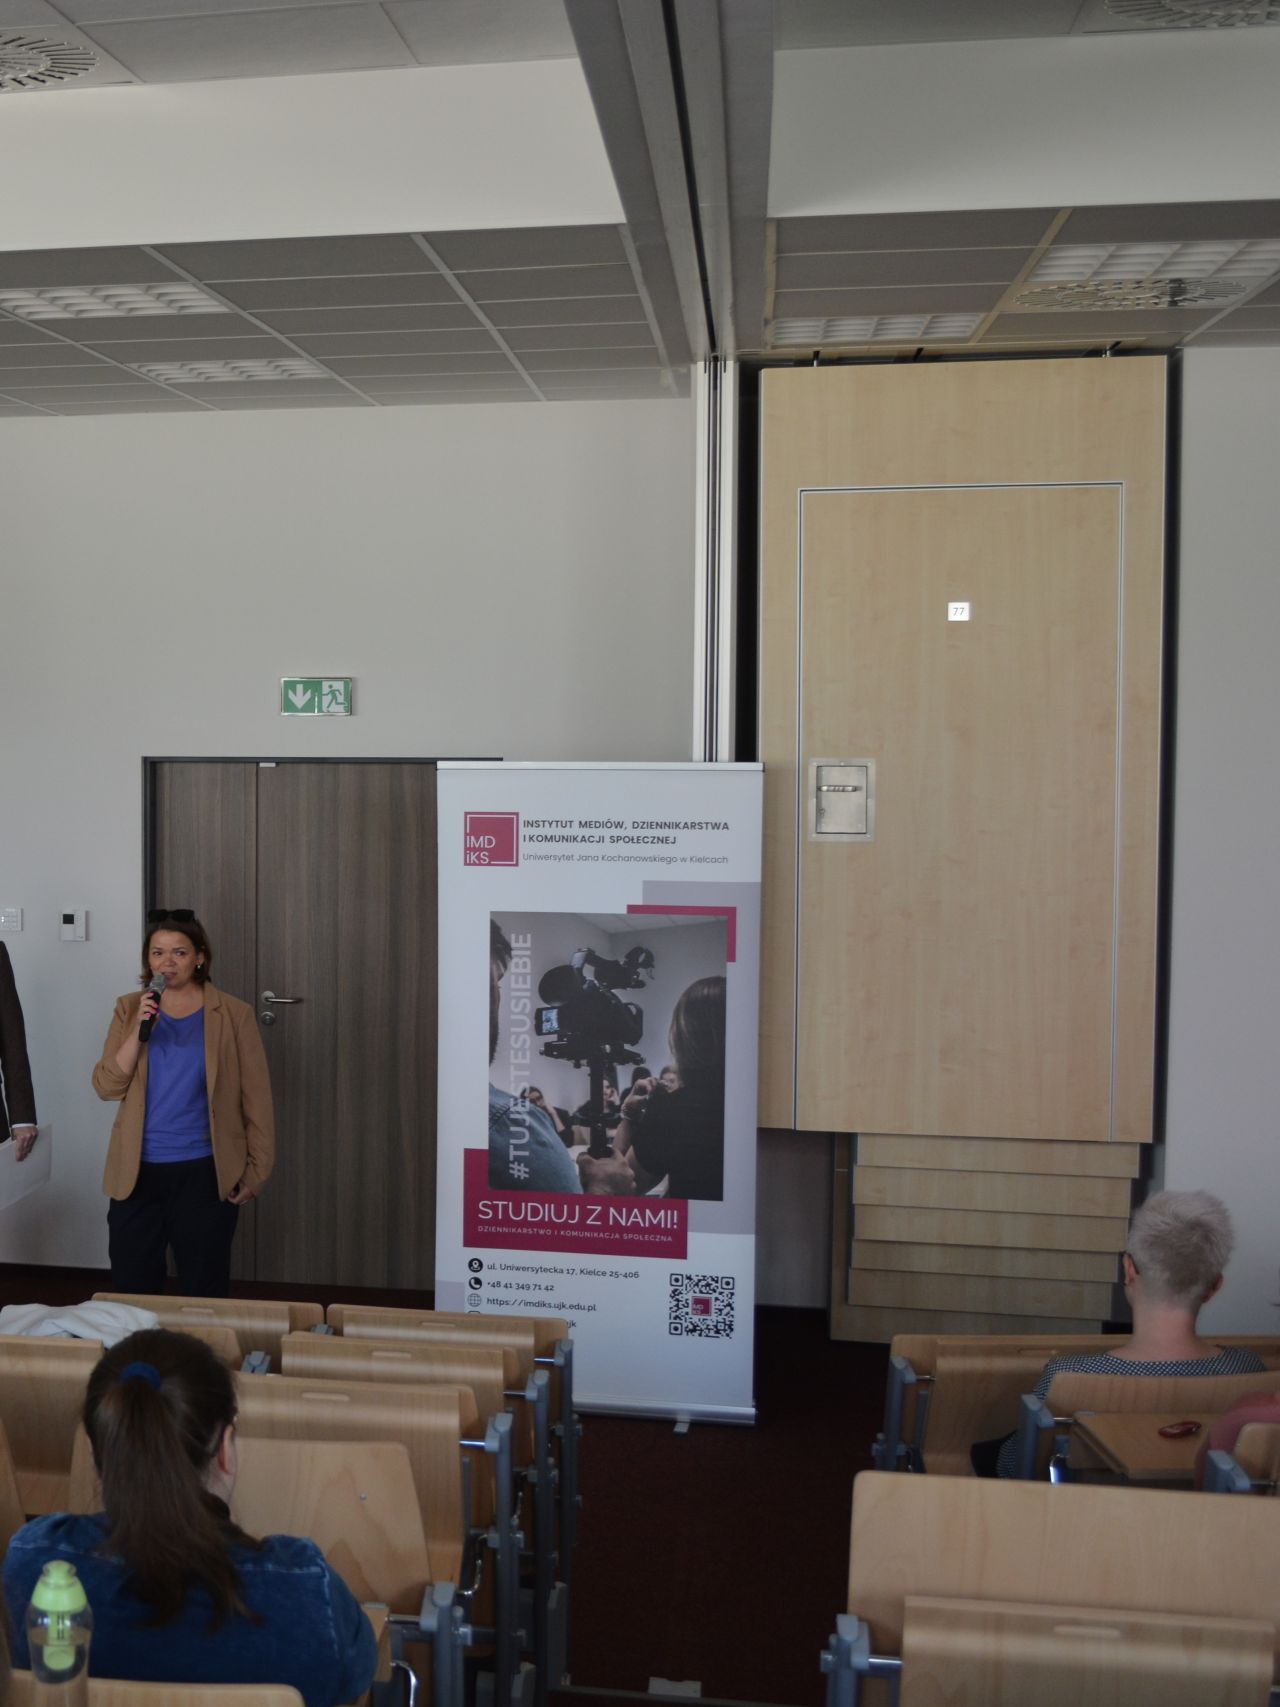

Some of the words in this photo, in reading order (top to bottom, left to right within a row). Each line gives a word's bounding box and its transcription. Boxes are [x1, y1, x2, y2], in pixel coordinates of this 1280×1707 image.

[953, 607, 965, 616] 77
[523, 820, 574, 829] INSTYTUT
[578, 818, 627, 830] MEDIÓW,
[632, 821, 730, 830] DZIENNIKARSTWA
[466, 835, 496, 848] IMD
[529, 834, 605, 844] KOMUNIKACJI
[609, 835, 676, 845] SPOŁECZNEJ
[523, 852, 575, 862] Uniwersytet
[577, 853, 599, 862] Jana
[601, 853, 677, 865] Kochanowskiego
[690, 855, 728, 864] Kielcach
[508, 933, 531, 1180] #TUJESTESUSIEBIE
[478, 1200, 580, 1223] STUDIUJ
[586, 1205, 602, 1224] Z
[609, 1207, 678, 1229] NAMI!
[478, 1225, 552, 1235] DZIENNIKARSTWO
[560, 1230, 620, 1239] KOMUNIKACJA
[623, 1234, 673, 1242] SPOŁECZNA
[487, 1263, 498, 1271] ul.
[499, 1264, 564, 1276] Uniwersytecka
[579, 1268, 607, 1277] Kielce
[609, 1271, 640, 1279] 25-406
[515, 1283, 530, 1291] 349
[532, 1284, 542, 1292] 71
[486, 1297, 597, 1312] https://imdiks.ujk.edu.pl
